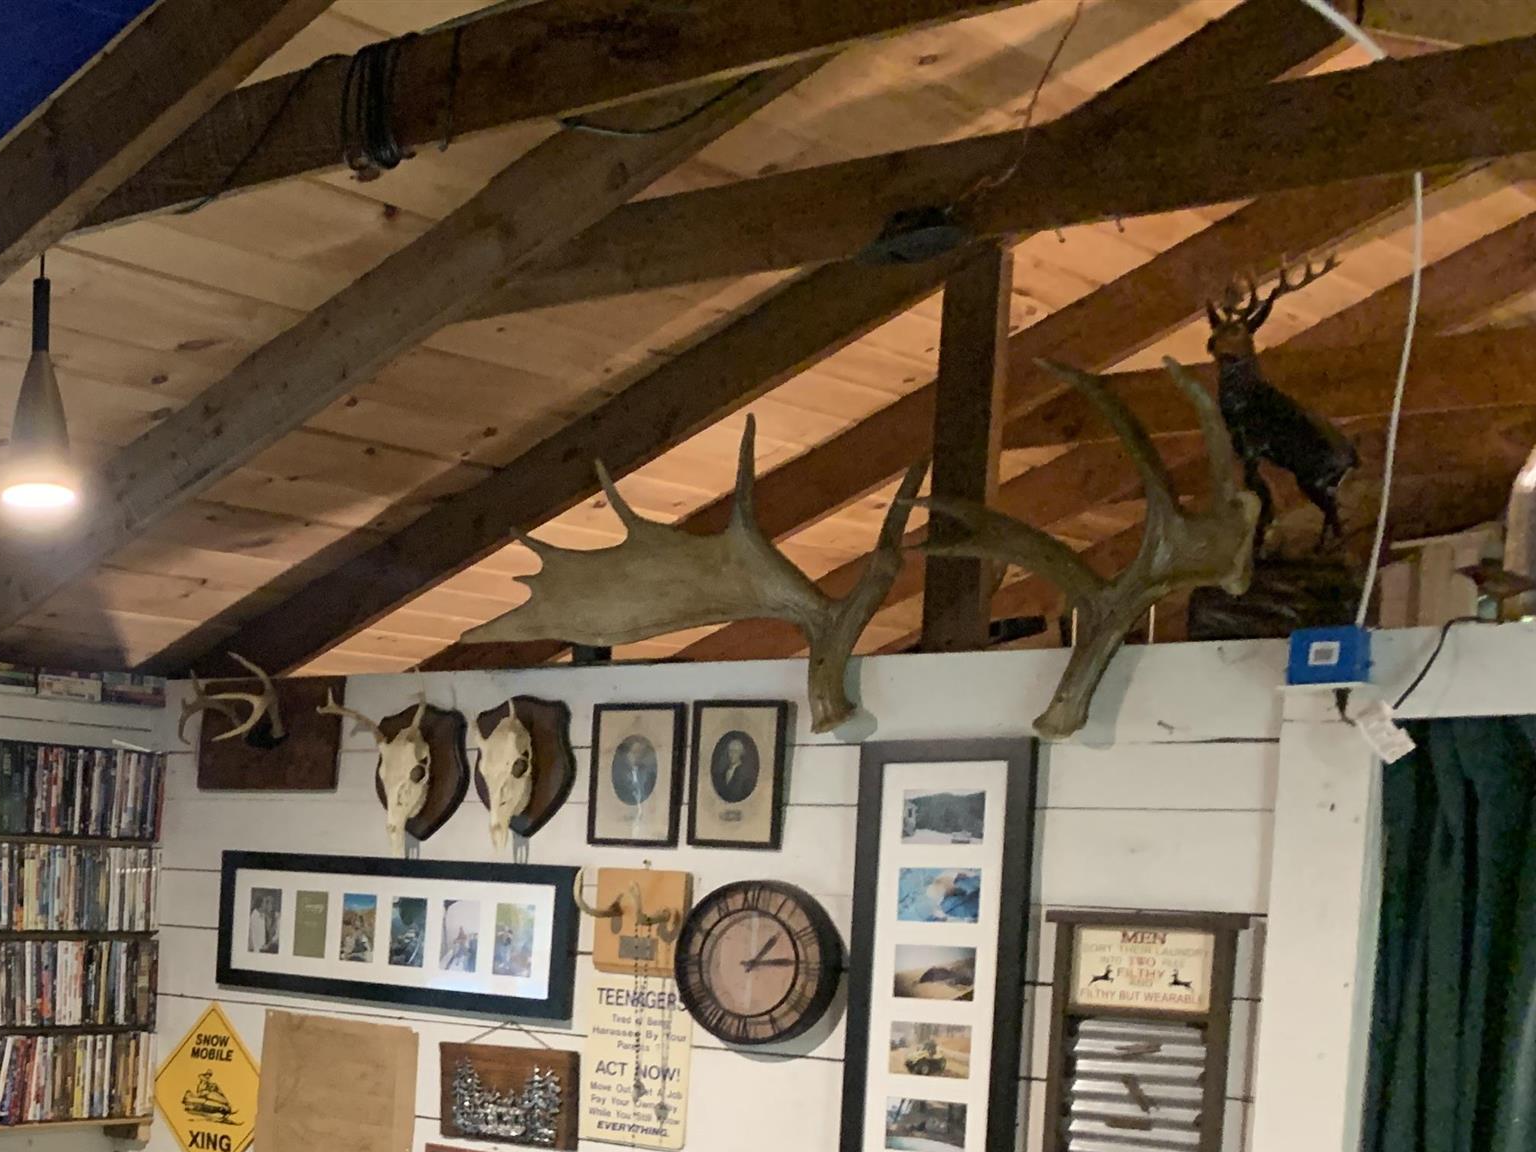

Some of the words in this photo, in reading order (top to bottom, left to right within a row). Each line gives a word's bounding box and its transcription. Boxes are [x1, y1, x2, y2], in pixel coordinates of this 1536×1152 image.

[1120, 930, 1167, 944] MEN
[1119, 990, 1140, 1001] BUT
[592, 1026, 640, 1038] Harasse
[195, 1033, 230, 1048] SNOW
[190, 1047, 234, 1062] MOBILE
[595, 1059, 628, 1076] ACT
[636, 1064, 681, 1082] NOW!
[188, 1130, 232, 1152] XING
